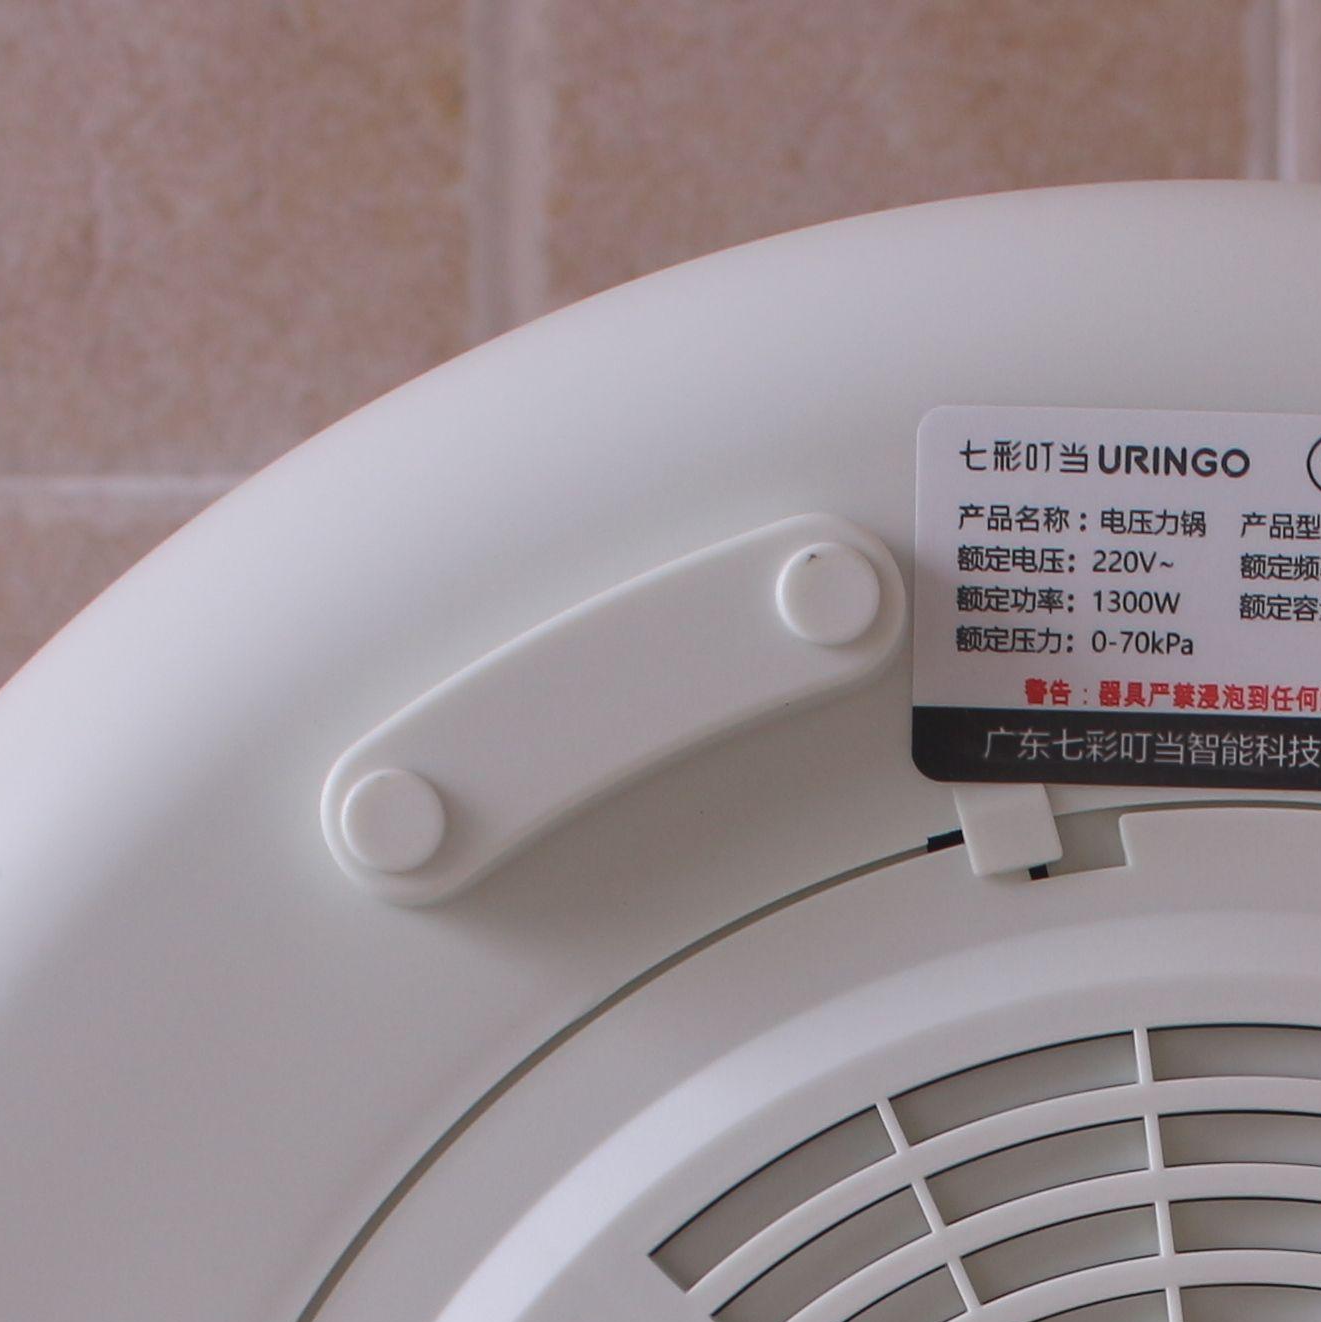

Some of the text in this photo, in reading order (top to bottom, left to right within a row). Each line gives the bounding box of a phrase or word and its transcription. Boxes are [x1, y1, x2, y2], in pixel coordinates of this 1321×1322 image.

[959, 440, 1251, 478] 七彩叮当 URINGO
[958, 504, 1207, 538] 产品名称： 电压力锅
[957, 545, 1174, 574] 额定电压： 220V~
[956, 585, 1180, 614] 额定功率： 1300W
[956, 625, 1194, 655] 额定压力： 0-70kPa
